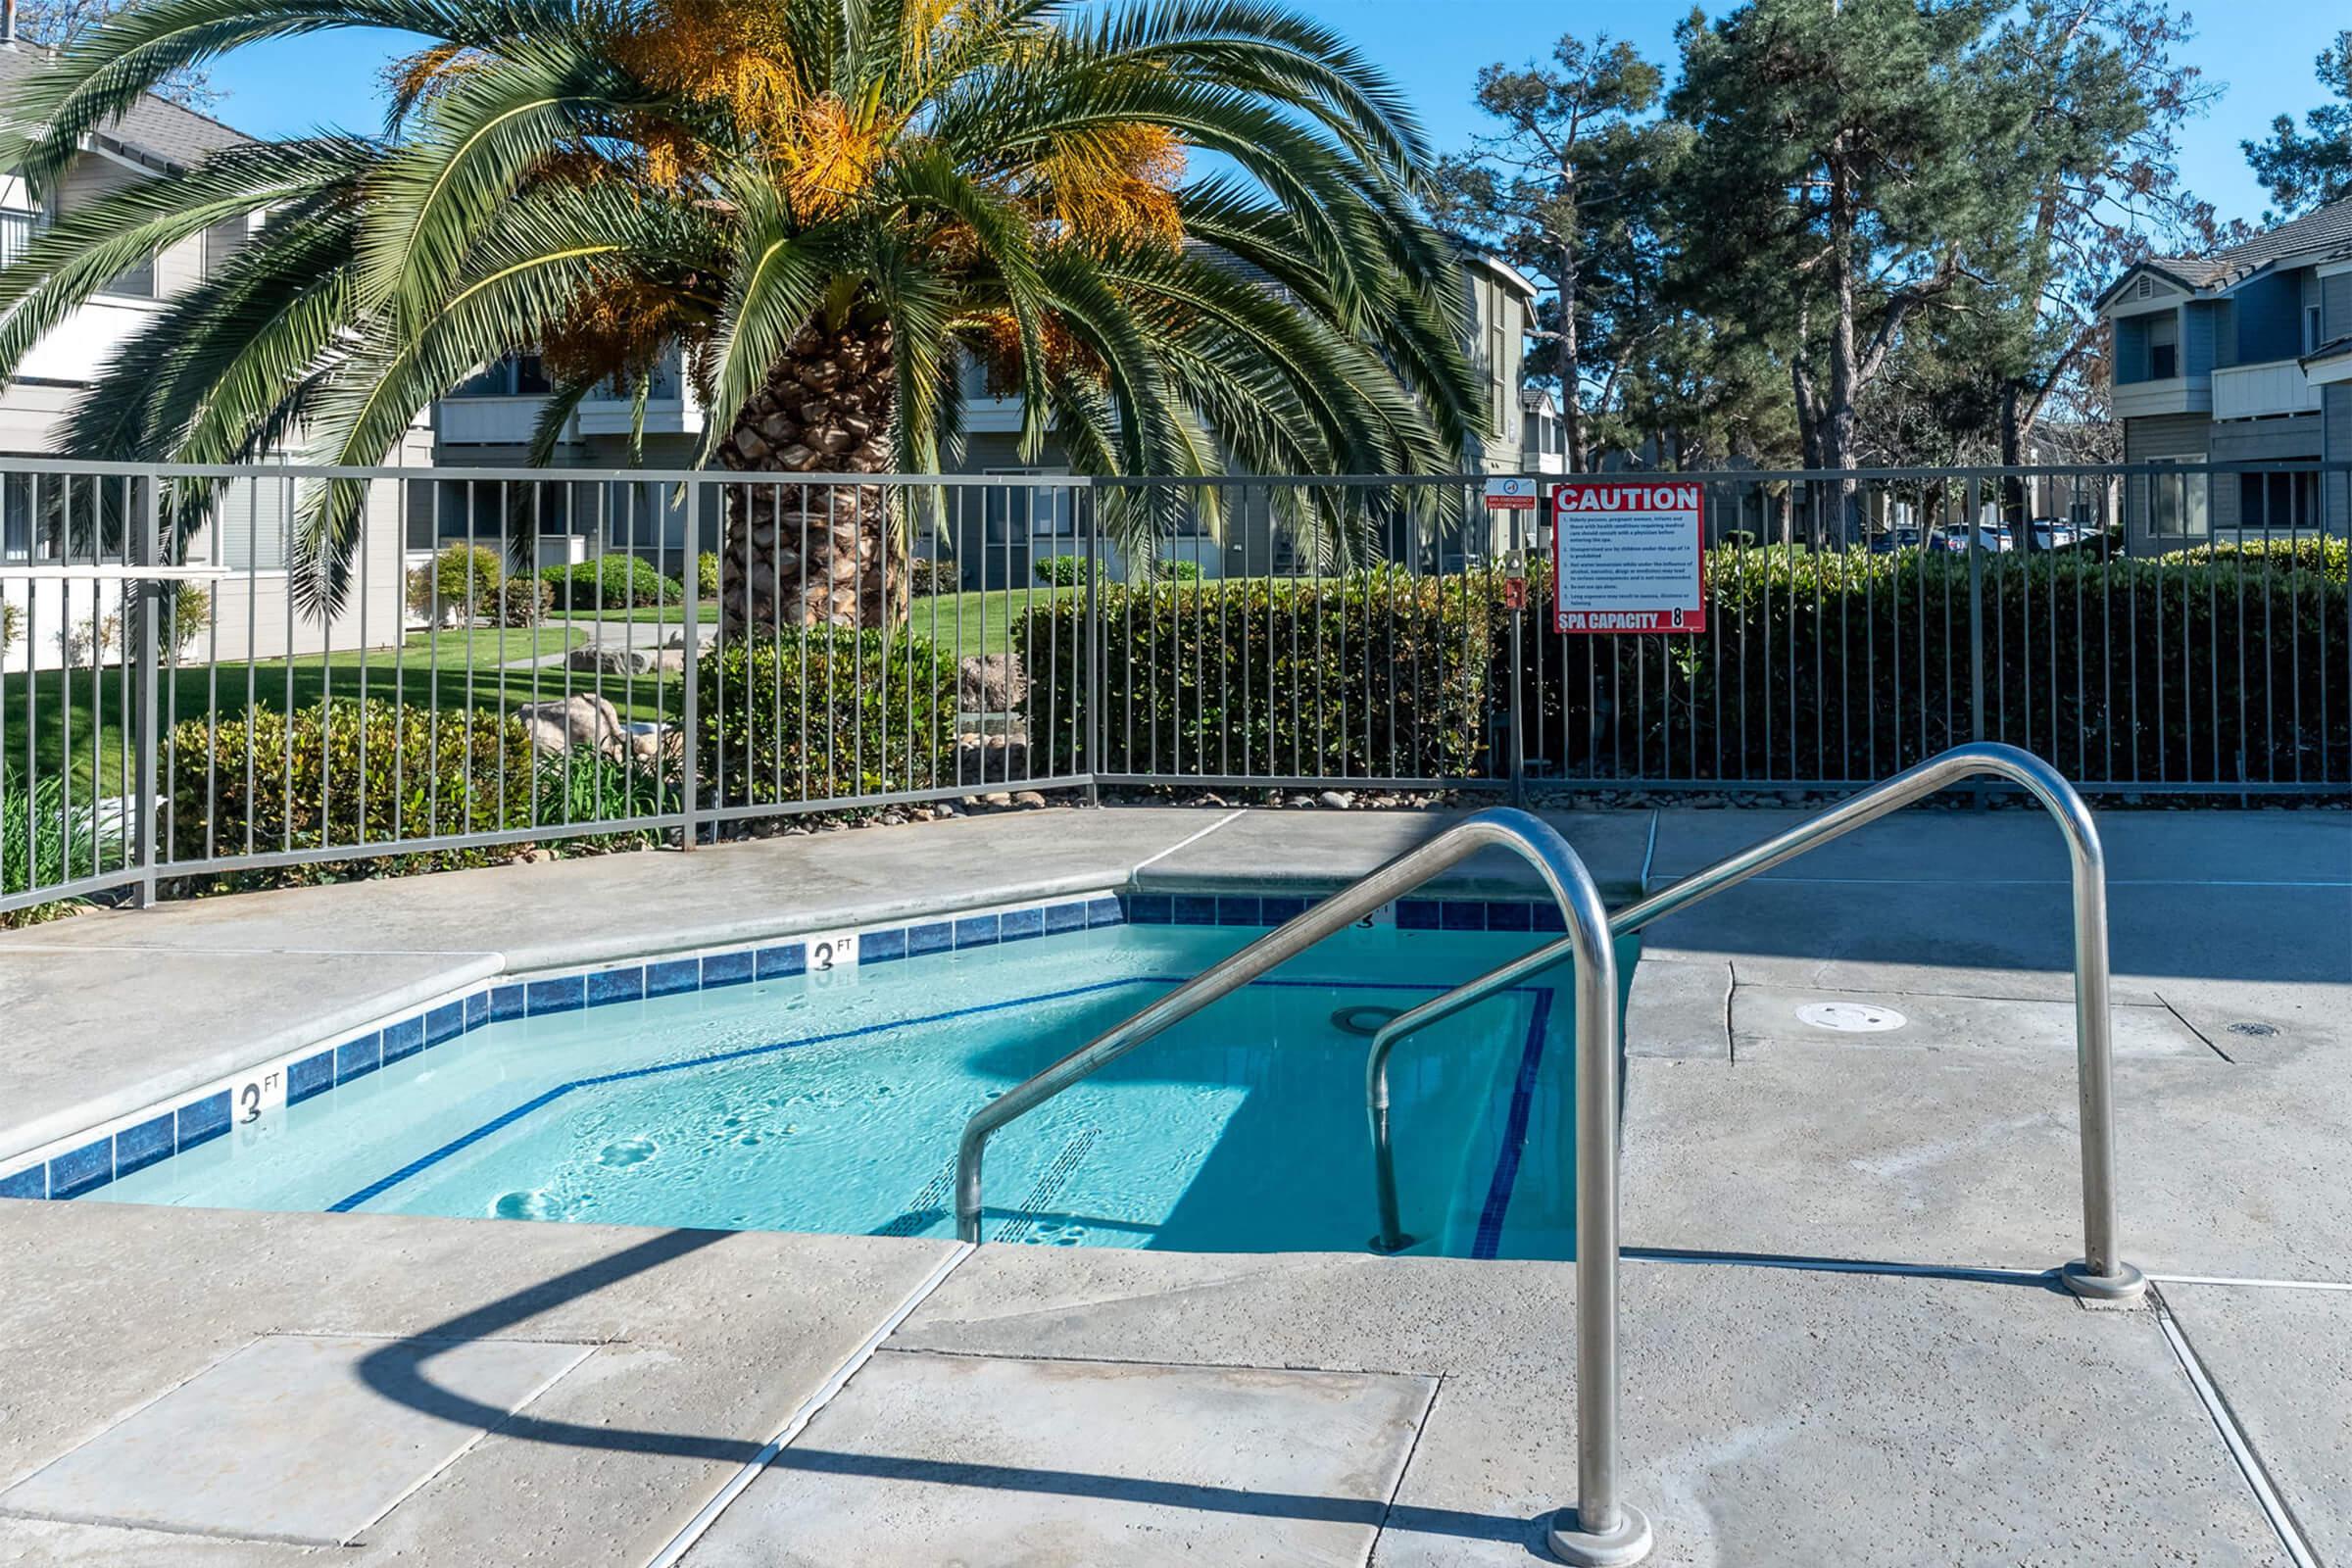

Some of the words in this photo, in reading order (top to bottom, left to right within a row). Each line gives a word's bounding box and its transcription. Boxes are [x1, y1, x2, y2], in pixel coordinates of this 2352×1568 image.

[1558, 487, 1698, 511] CAUTION
[1558, 612, 1586, 629] SPA
[1589, 612, 1658, 629] CAPACITY
[1673, 607, 1683, 626] 8
[813, 942, 834, 972] 3
[837, 937, 853, 953] FT
[240, 1083, 262, 1125] 3
[264, 1072, 281, 1093] FT
